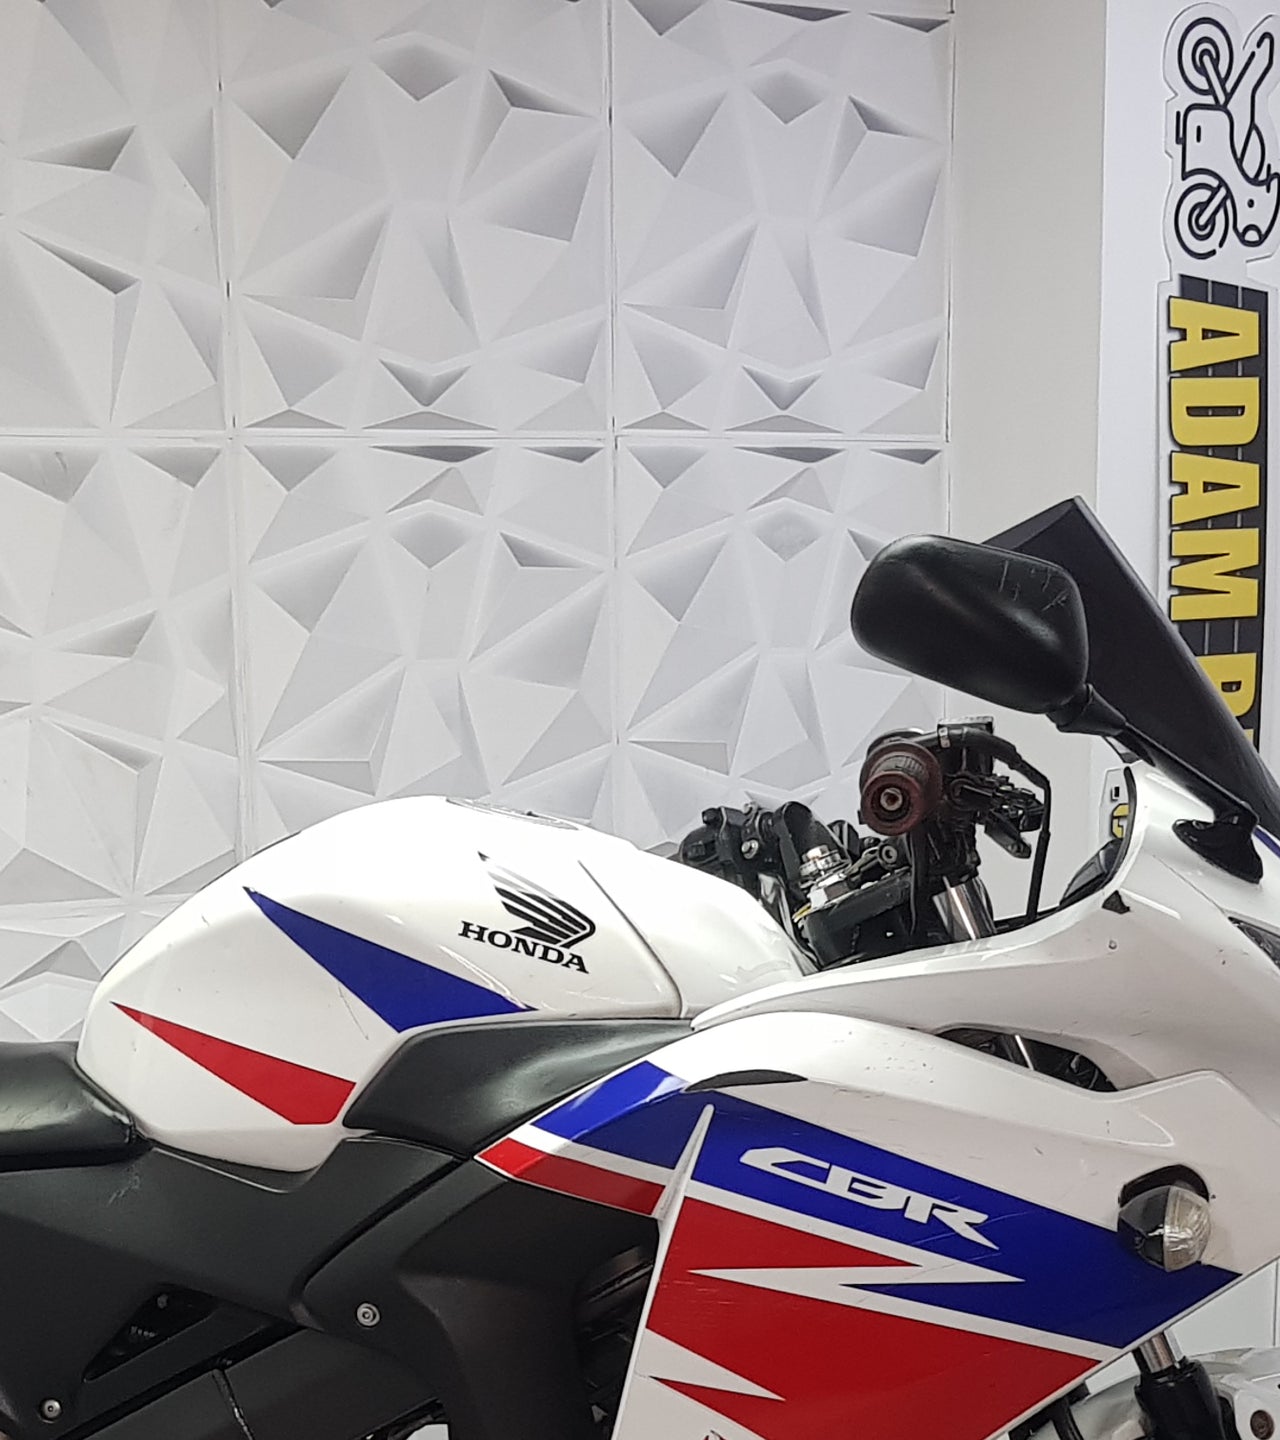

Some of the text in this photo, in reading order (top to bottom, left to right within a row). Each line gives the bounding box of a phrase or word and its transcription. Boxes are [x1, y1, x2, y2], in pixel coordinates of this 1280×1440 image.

[1167, 296, 1261, 621] ADAM
[458, 921, 590, 974] HONDA
[739, 1147, 1000, 1250] CBR
